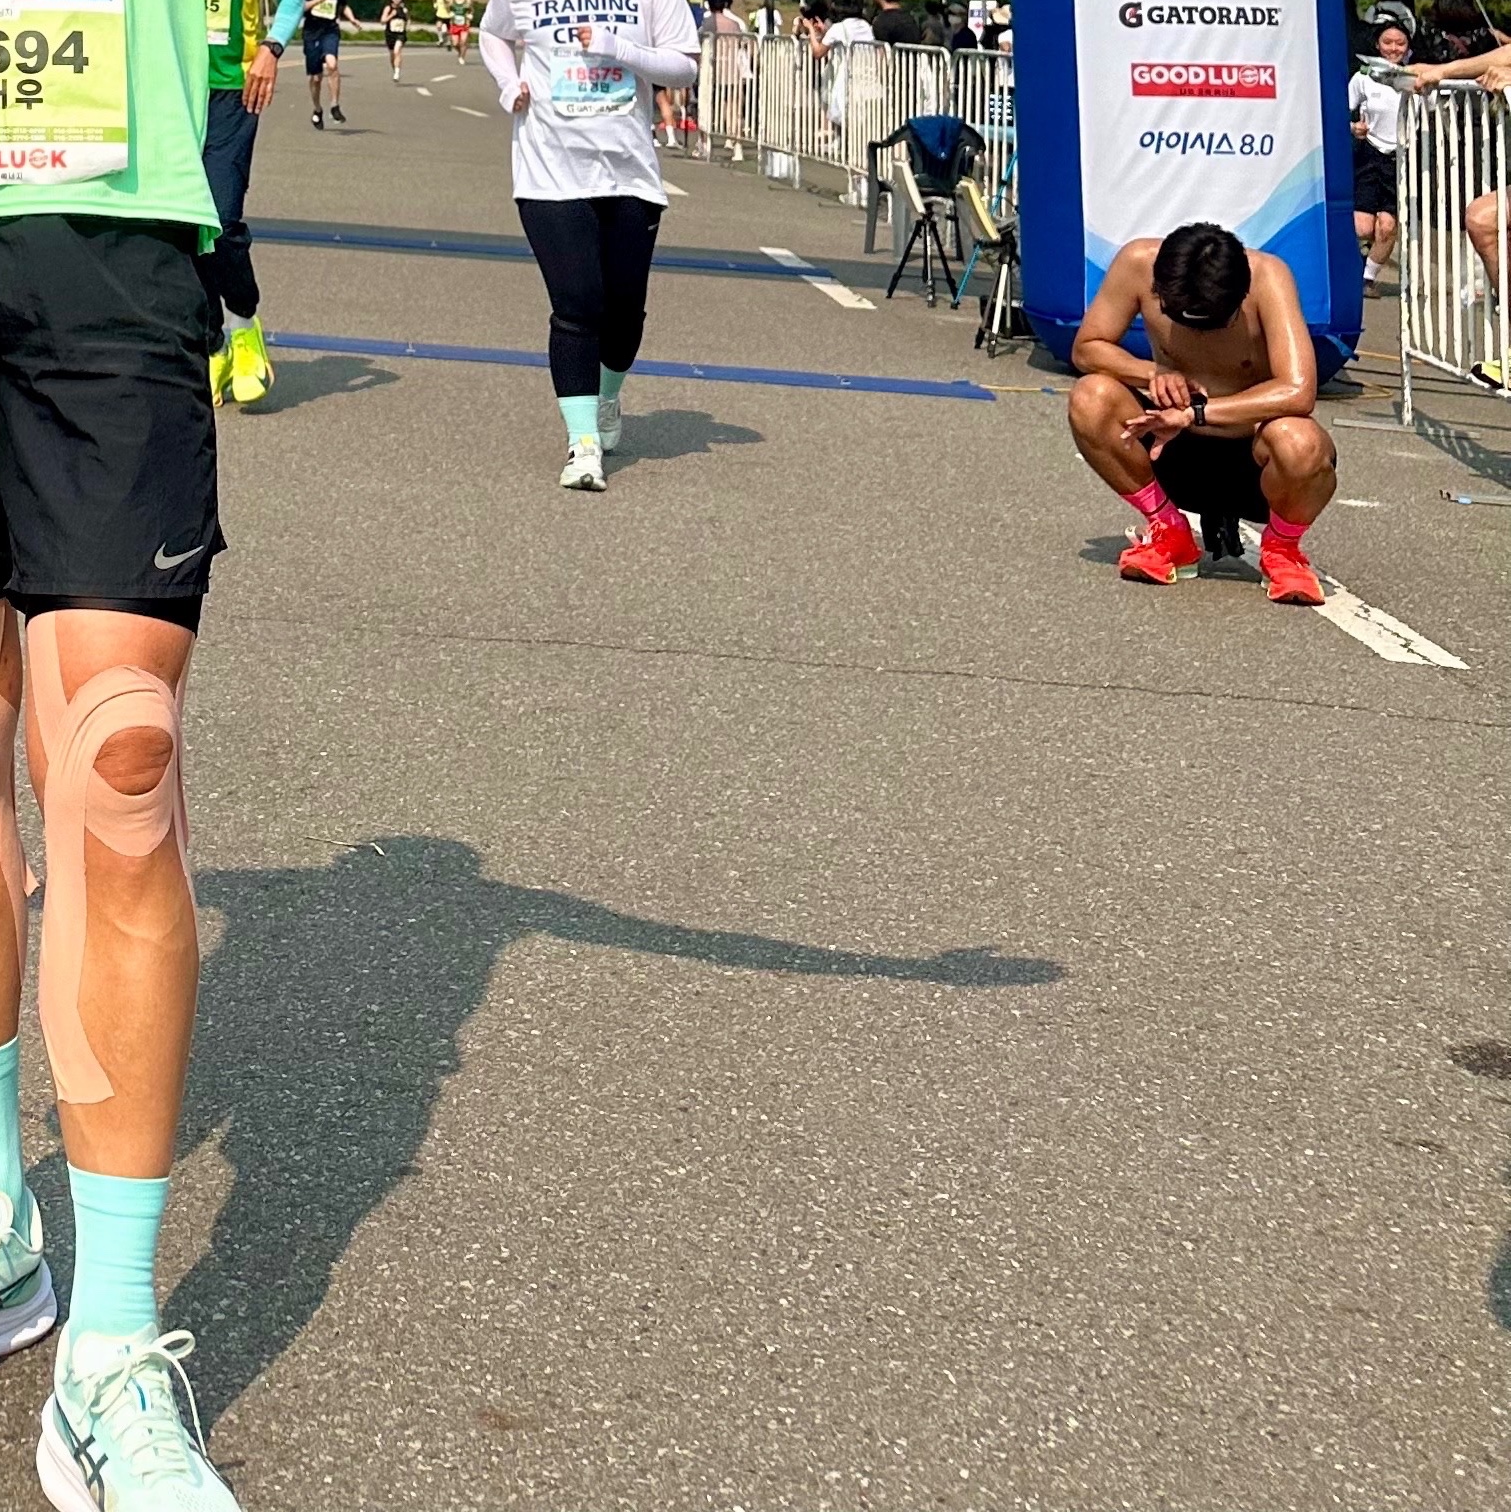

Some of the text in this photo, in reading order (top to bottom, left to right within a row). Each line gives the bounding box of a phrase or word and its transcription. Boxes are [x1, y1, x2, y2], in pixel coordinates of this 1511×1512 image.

[1146, 5, 1281, 26] GATORADE
[553, 25, 618, 44] CR
[1138, 130, 1274, 156] 아이시스 8.0
